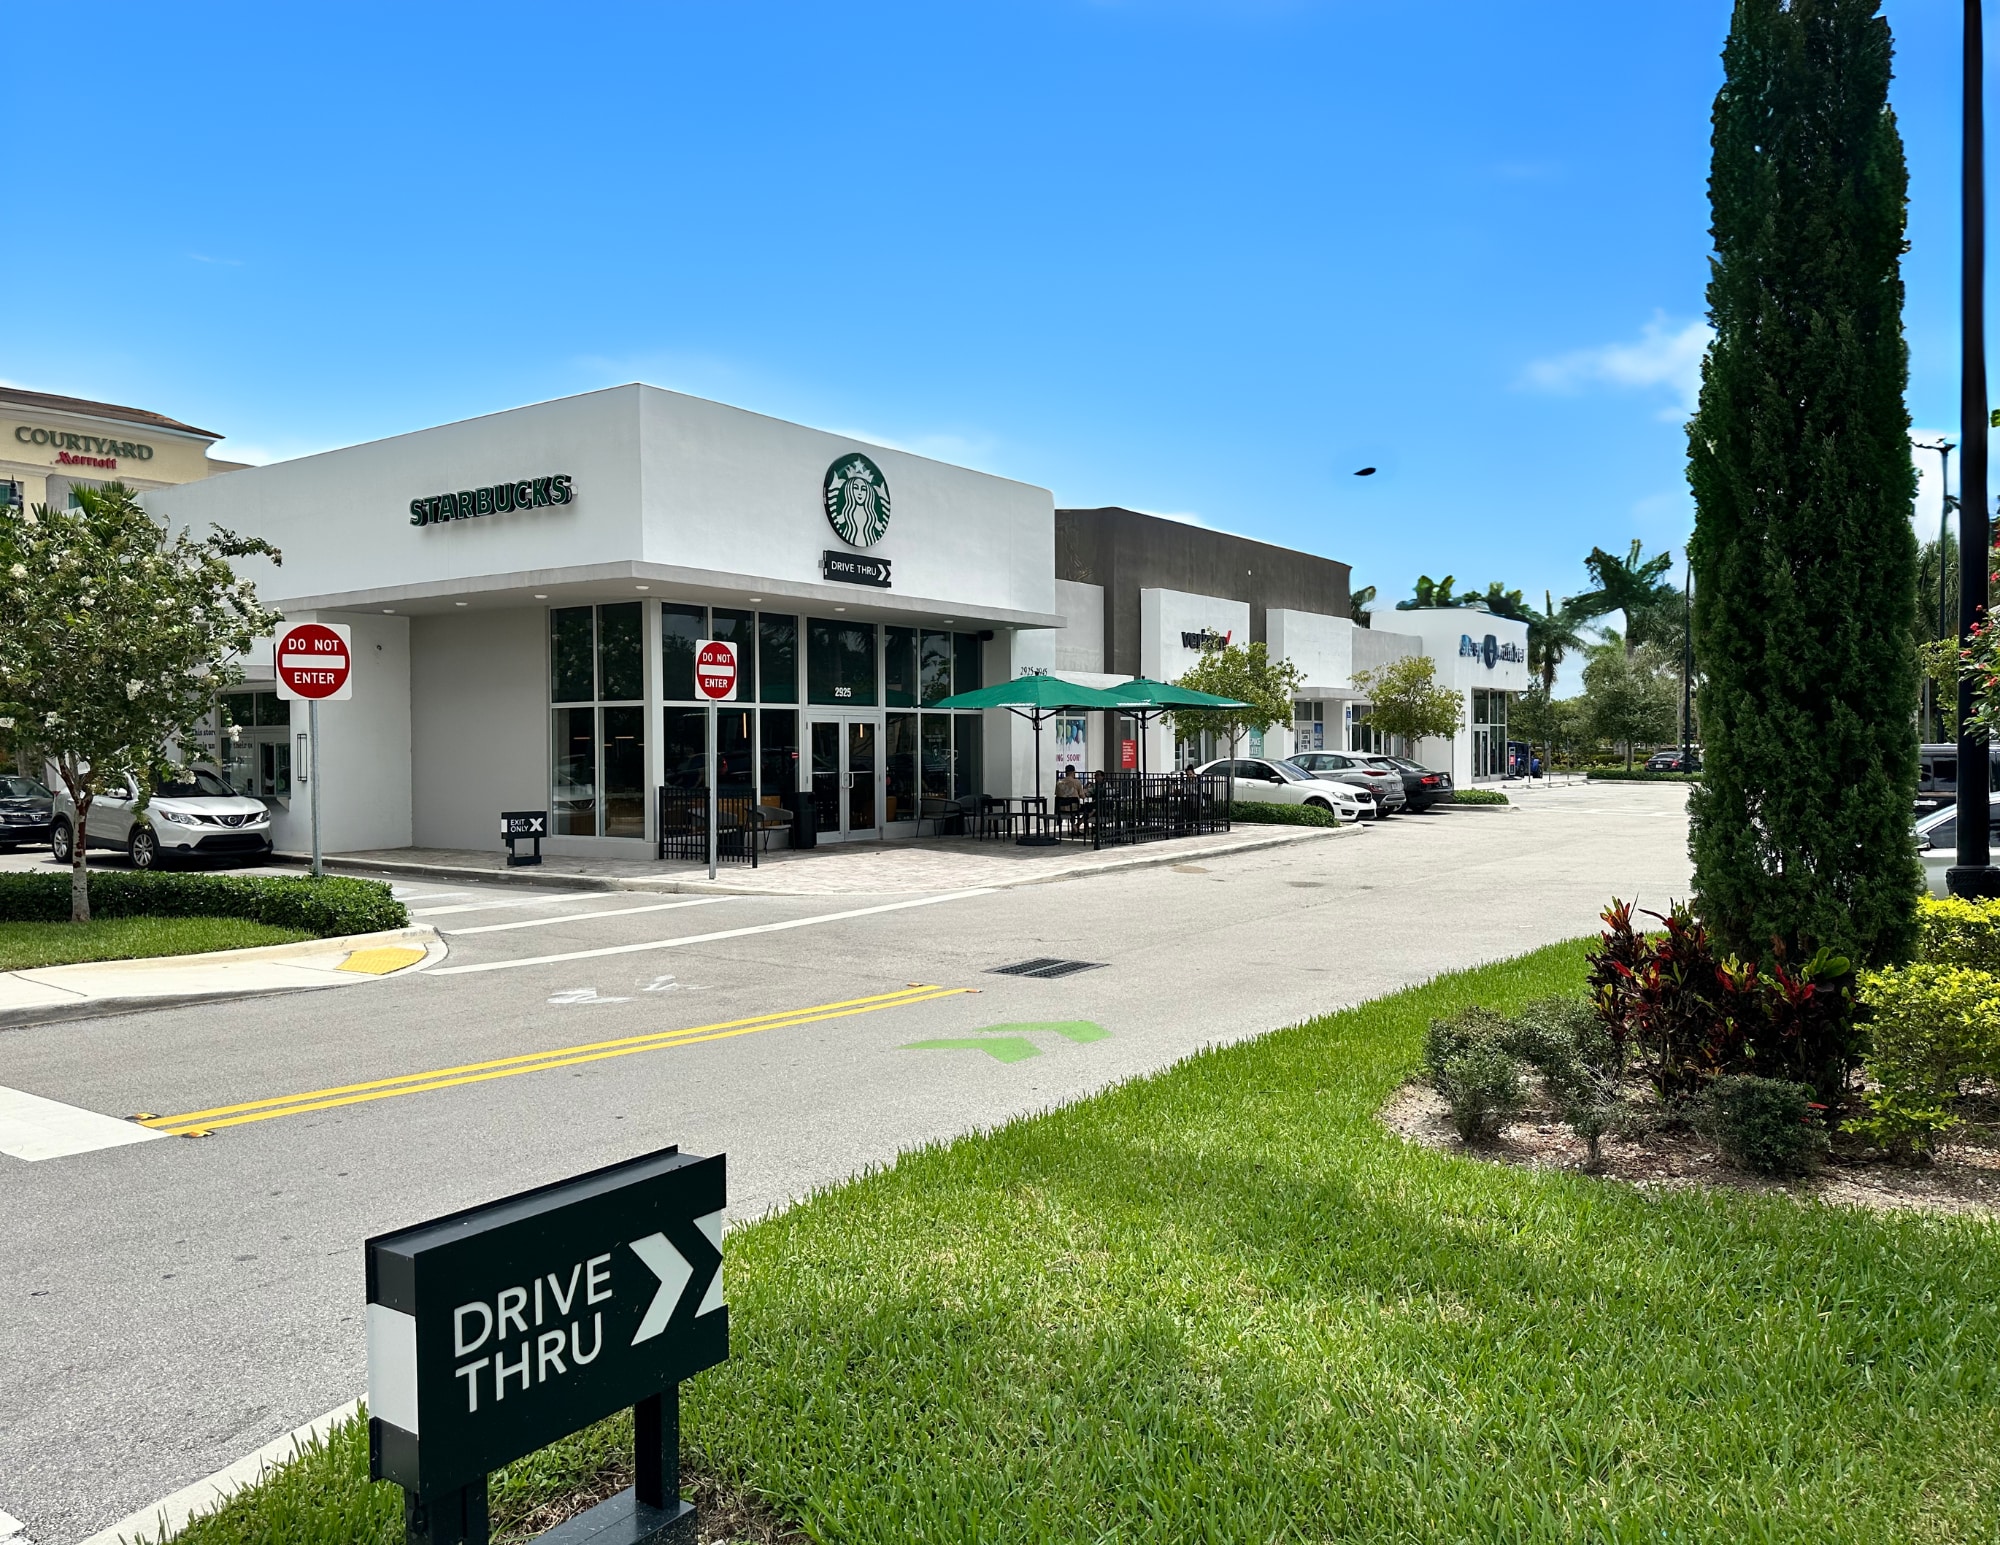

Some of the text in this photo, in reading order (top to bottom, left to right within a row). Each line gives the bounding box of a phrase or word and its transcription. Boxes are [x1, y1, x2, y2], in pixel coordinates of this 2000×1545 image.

[15, 426, 153, 460] COURTYARD
[55, 451, 117, 469] Marriott
[410, 474, 572, 526] STARBUCKS
[831, 560, 877, 576] DRIVE THRU
[288, 638, 339, 652] DO NOT
[702, 652, 731, 663] DO NOT
[294, 671, 335, 684] ENTER
[704, 678, 728, 688] ENTER
[834, 687, 852, 698] 2925
[510, 818, 526, 826] EXIT
[510, 825, 529, 833] ONLY
[454, 1253, 612, 1358] DRIVE
[455, 1312, 602, 1413] THRU
